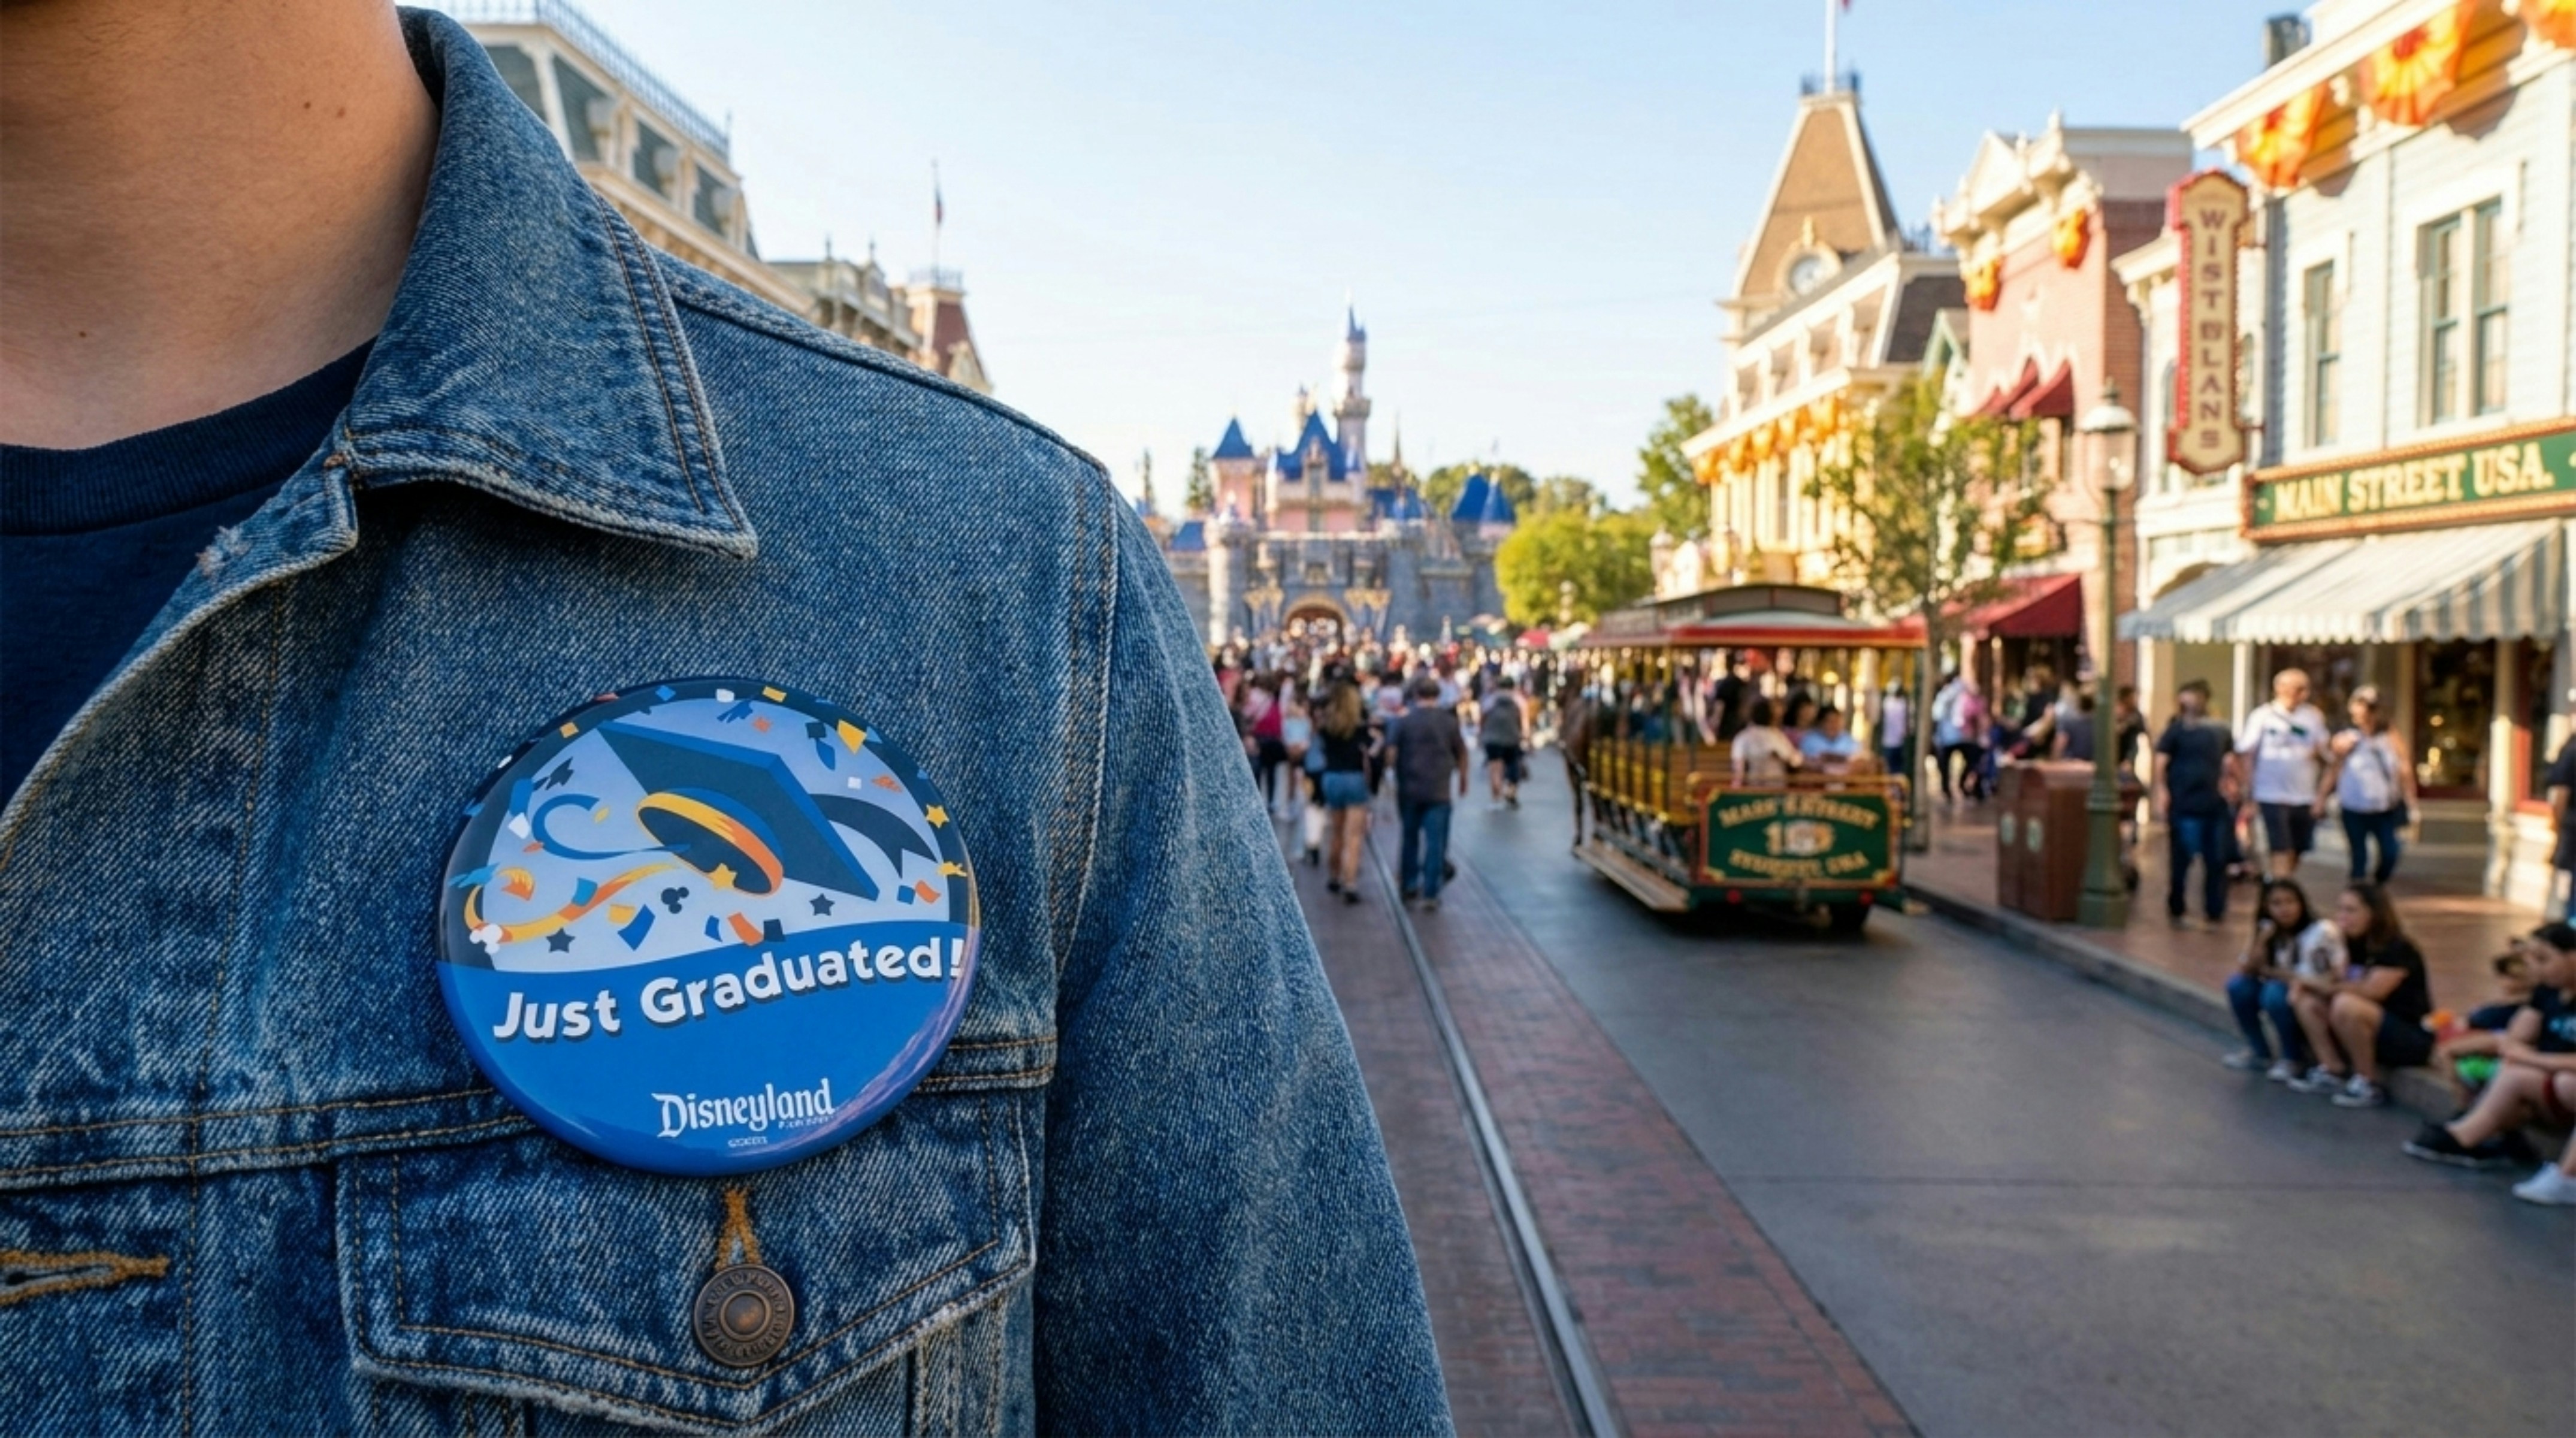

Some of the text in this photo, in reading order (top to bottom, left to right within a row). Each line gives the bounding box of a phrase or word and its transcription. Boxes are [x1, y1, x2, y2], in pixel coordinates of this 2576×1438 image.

[2275, 442, 2555, 522] MAIN STREET USA.
[493, 937, 965, 1041] Just Graduated!
[651, 1077, 836, 1138] Disneyland
